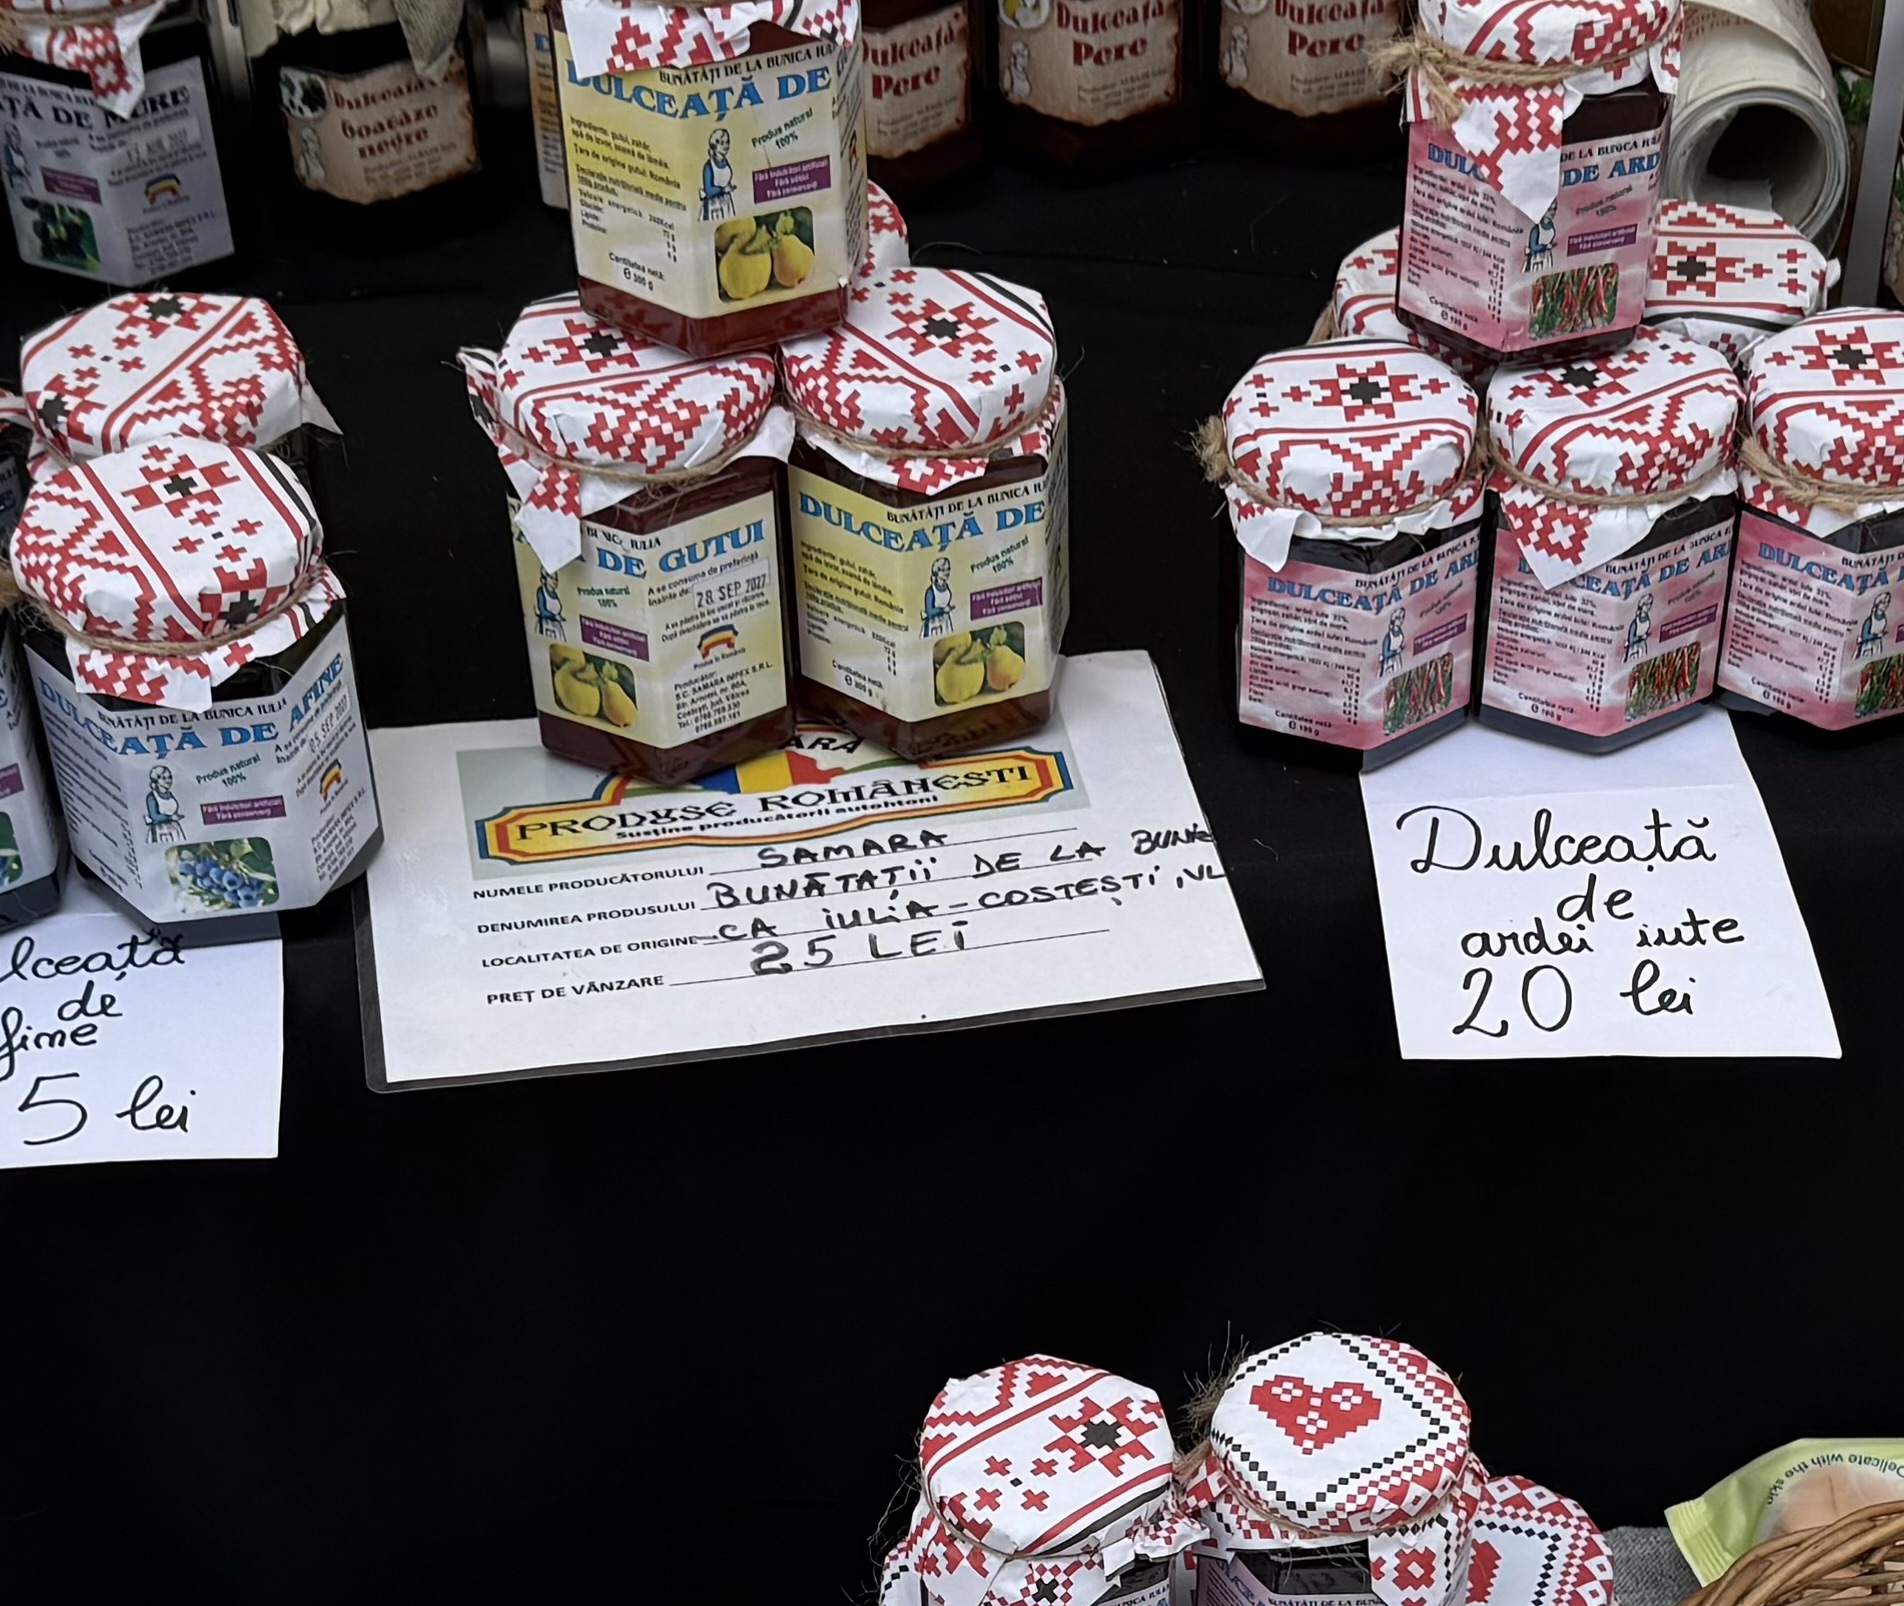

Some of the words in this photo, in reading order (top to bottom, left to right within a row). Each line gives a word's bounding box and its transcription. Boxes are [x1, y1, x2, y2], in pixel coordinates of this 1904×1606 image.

[745, 58, 764, 75] LA
[1072, 34, 1149, 67] Pere
[777, 65, 832, 101] DE
[798, 490, 985, 554] DULCEAȚĂ
[995, 500, 1047, 533] DE
[596, 546, 647, 580] DE
[658, 519, 766, 575] GUTUI
[717, 579, 744, 604] SEP
[472, 882, 545, 900] NUMELE
[548, 865, 705, 893] PRODUCĂTORULUI
[756, 829, 949, 868] SAMARA
[1395, 803, 1719, 875] Dulceață
[476, 913, 584, 935] DENUMIREA
[586, 900, 696, 923] PRODUSULUI
[971, 851, 1023, 880] DE
[1048, 841, 1107, 863] LA
[1556, 872, 1636, 924] de
[481, 945, 597, 969] LOCALITATEA
[600, 941, 624, 957] DE
[626, 934, 698, 954] ORIGINE
[1461, 916, 1596, 959] ardei
[1635, 907, 1747, 950] iute
[57, 979, 124, 1022] de
[486, 986, 537, 1007] PREȚ
[540, 984, 568, 1000] DE
[570, 973, 666, 998] VÂNZARE
[1451, 963, 1574, 1038] 20
[1618, 957, 1698, 1017] lei
[115, 1074, 197, 1134] lei
[1810, 1453, 1846, 1472] with
